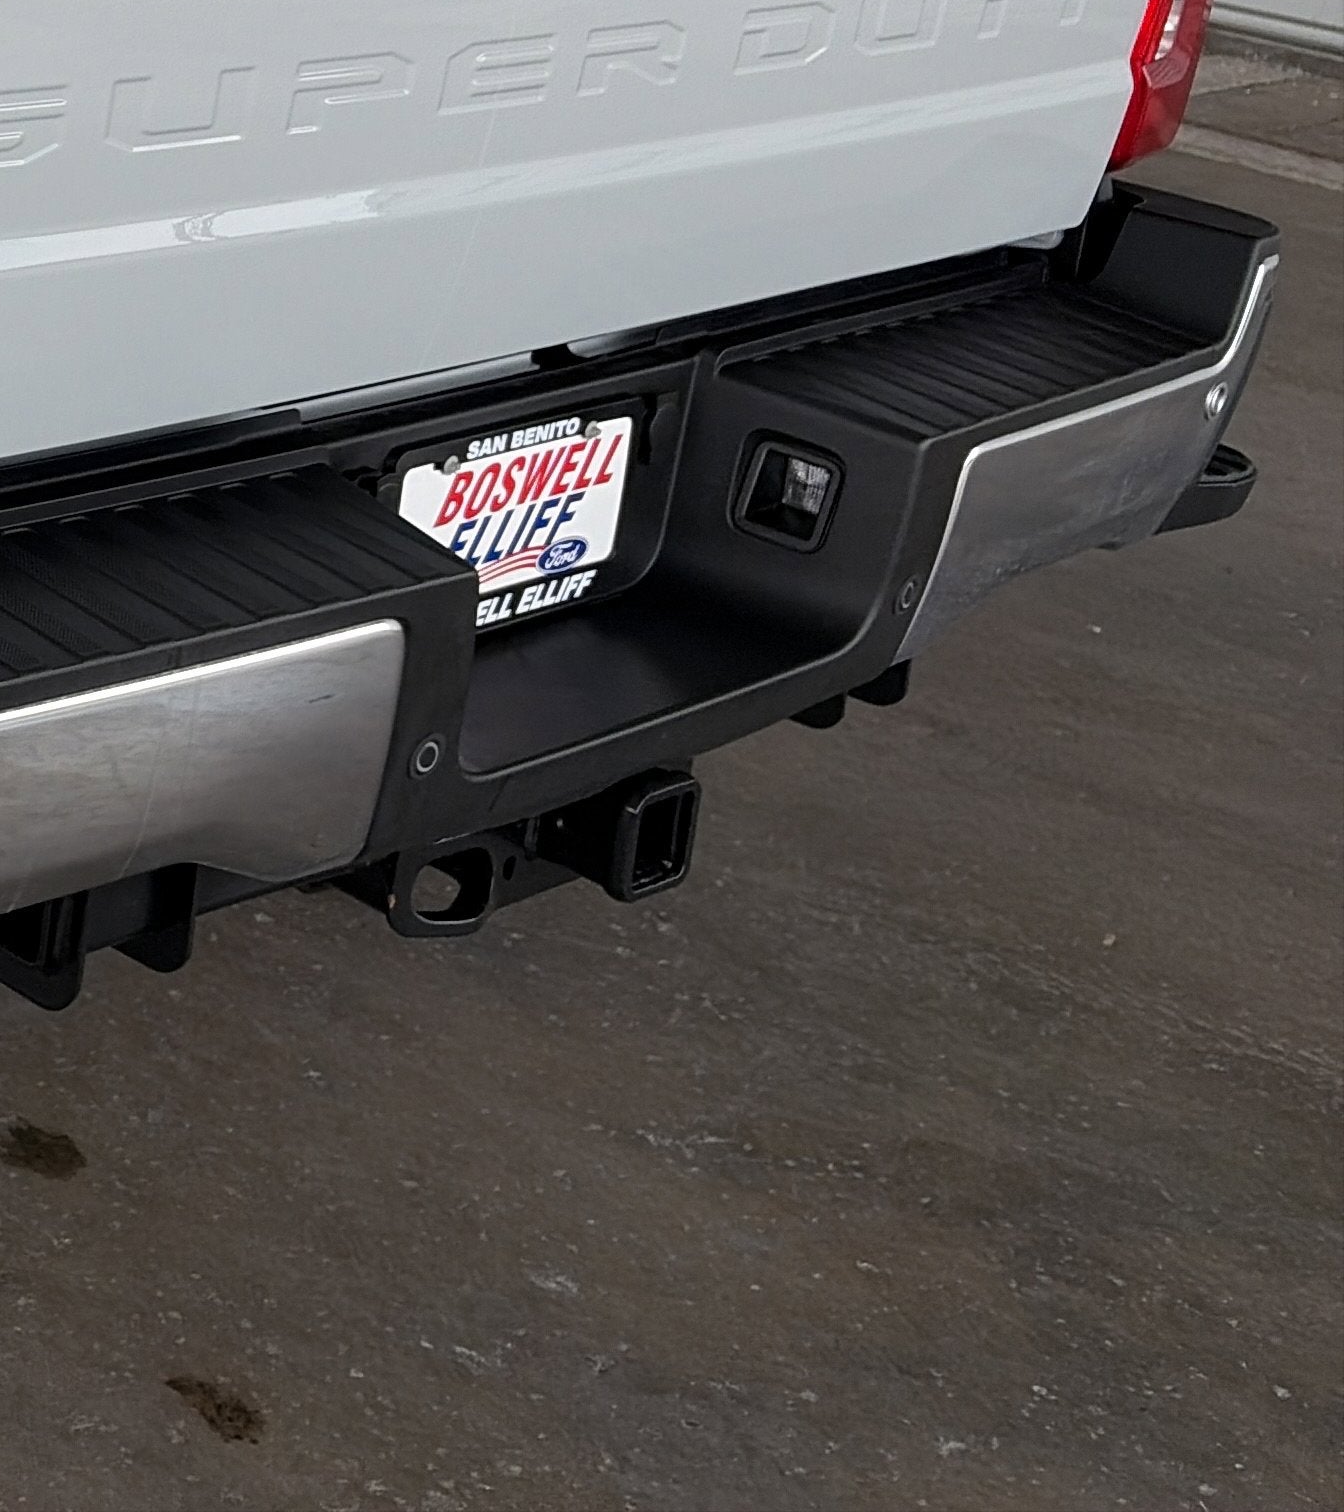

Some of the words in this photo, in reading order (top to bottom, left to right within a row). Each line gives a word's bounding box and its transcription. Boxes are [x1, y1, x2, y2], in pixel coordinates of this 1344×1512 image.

[466, 434, 506, 460] SAN
[510, 417, 581, 450] BENITO
[433, 433, 624, 528] BOSWELL
[450, 490, 586, 566] ELLIFF
[515, 569, 597, 615] ELLIFF
